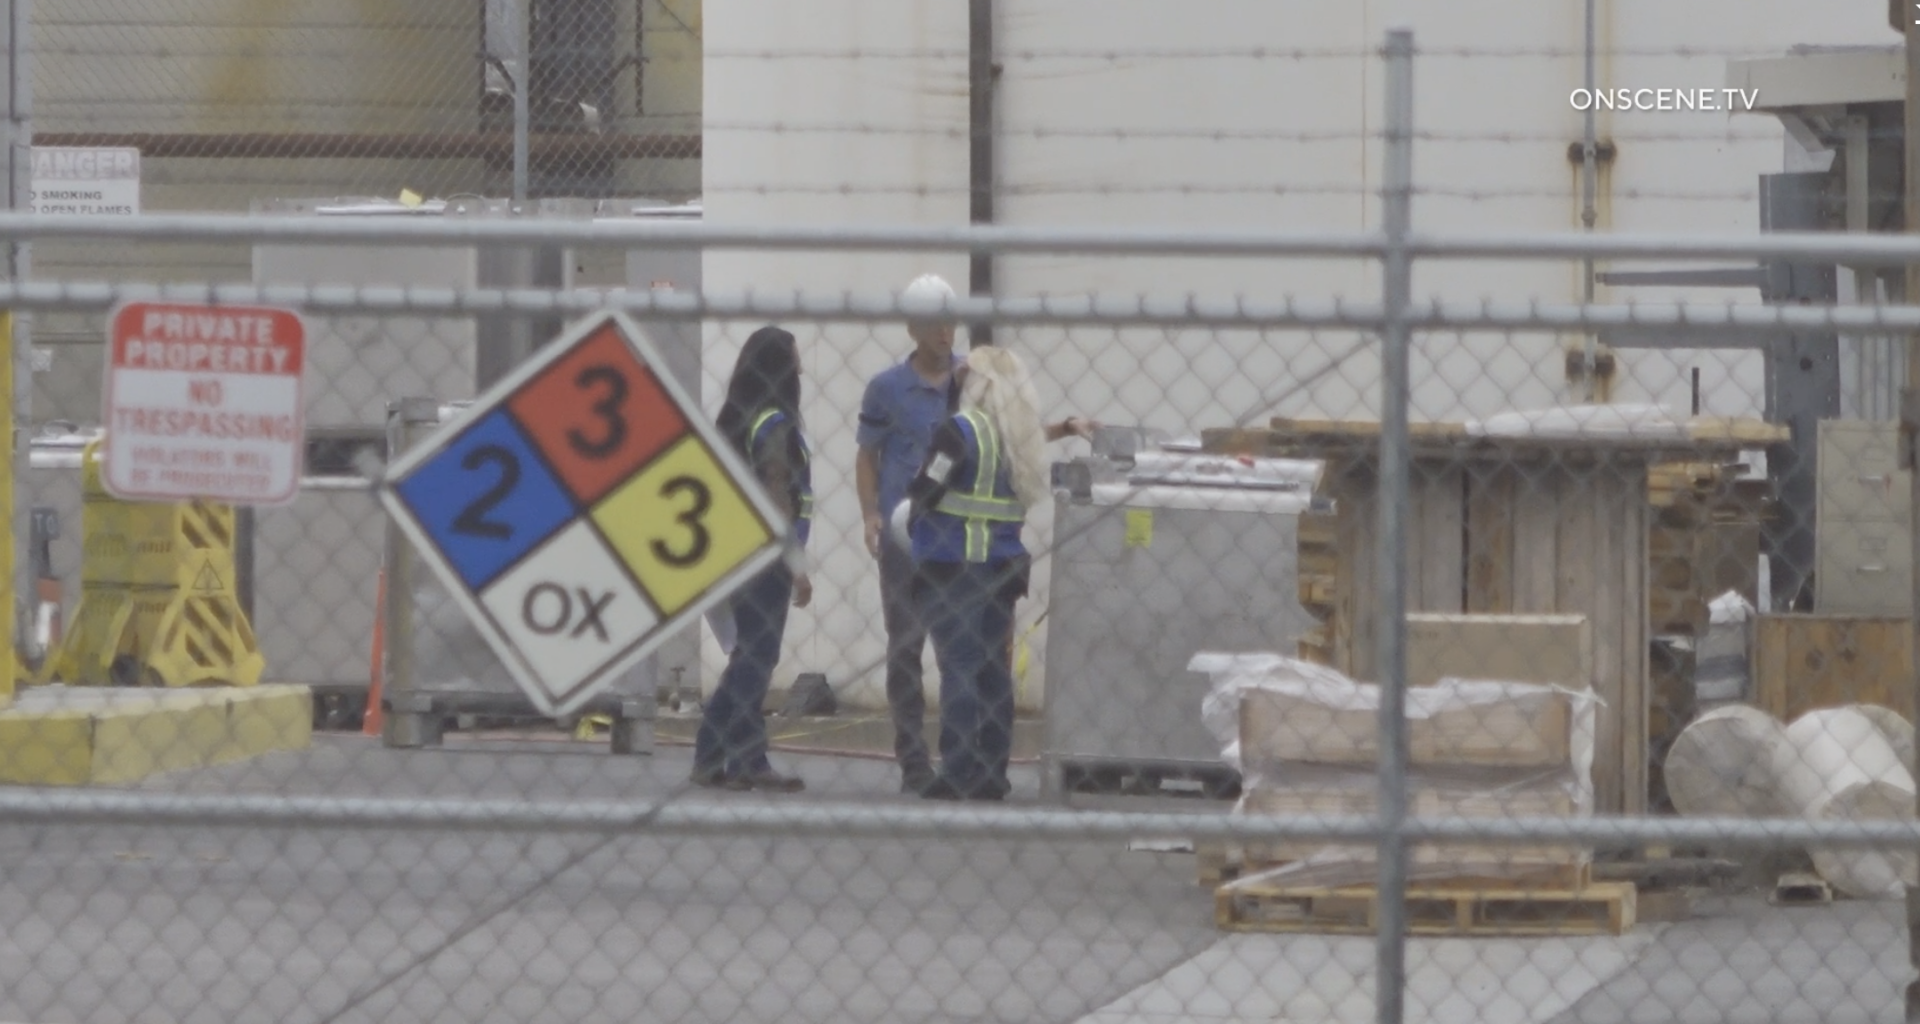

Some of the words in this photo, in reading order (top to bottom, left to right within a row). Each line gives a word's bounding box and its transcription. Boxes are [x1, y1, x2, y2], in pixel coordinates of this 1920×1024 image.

[31, 151, 132, 178] ANGER
[41, 190, 103, 200] SMOKING
[41, 205, 76, 214] OPEN
[80, 205, 132, 215] FLAMES
[143, 312, 273, 345] PRIVATE
[124, 340, 288, 373] PROPERTY
[188, 380, 224, 407] NO
[115, 407, 293, 444] TRESPASSING
[567, 365, 630, 460] 3
[450, 444, 522, 541] 2
[649, 474, 713, 570] 3
[521, 581, 617, 643] OX
